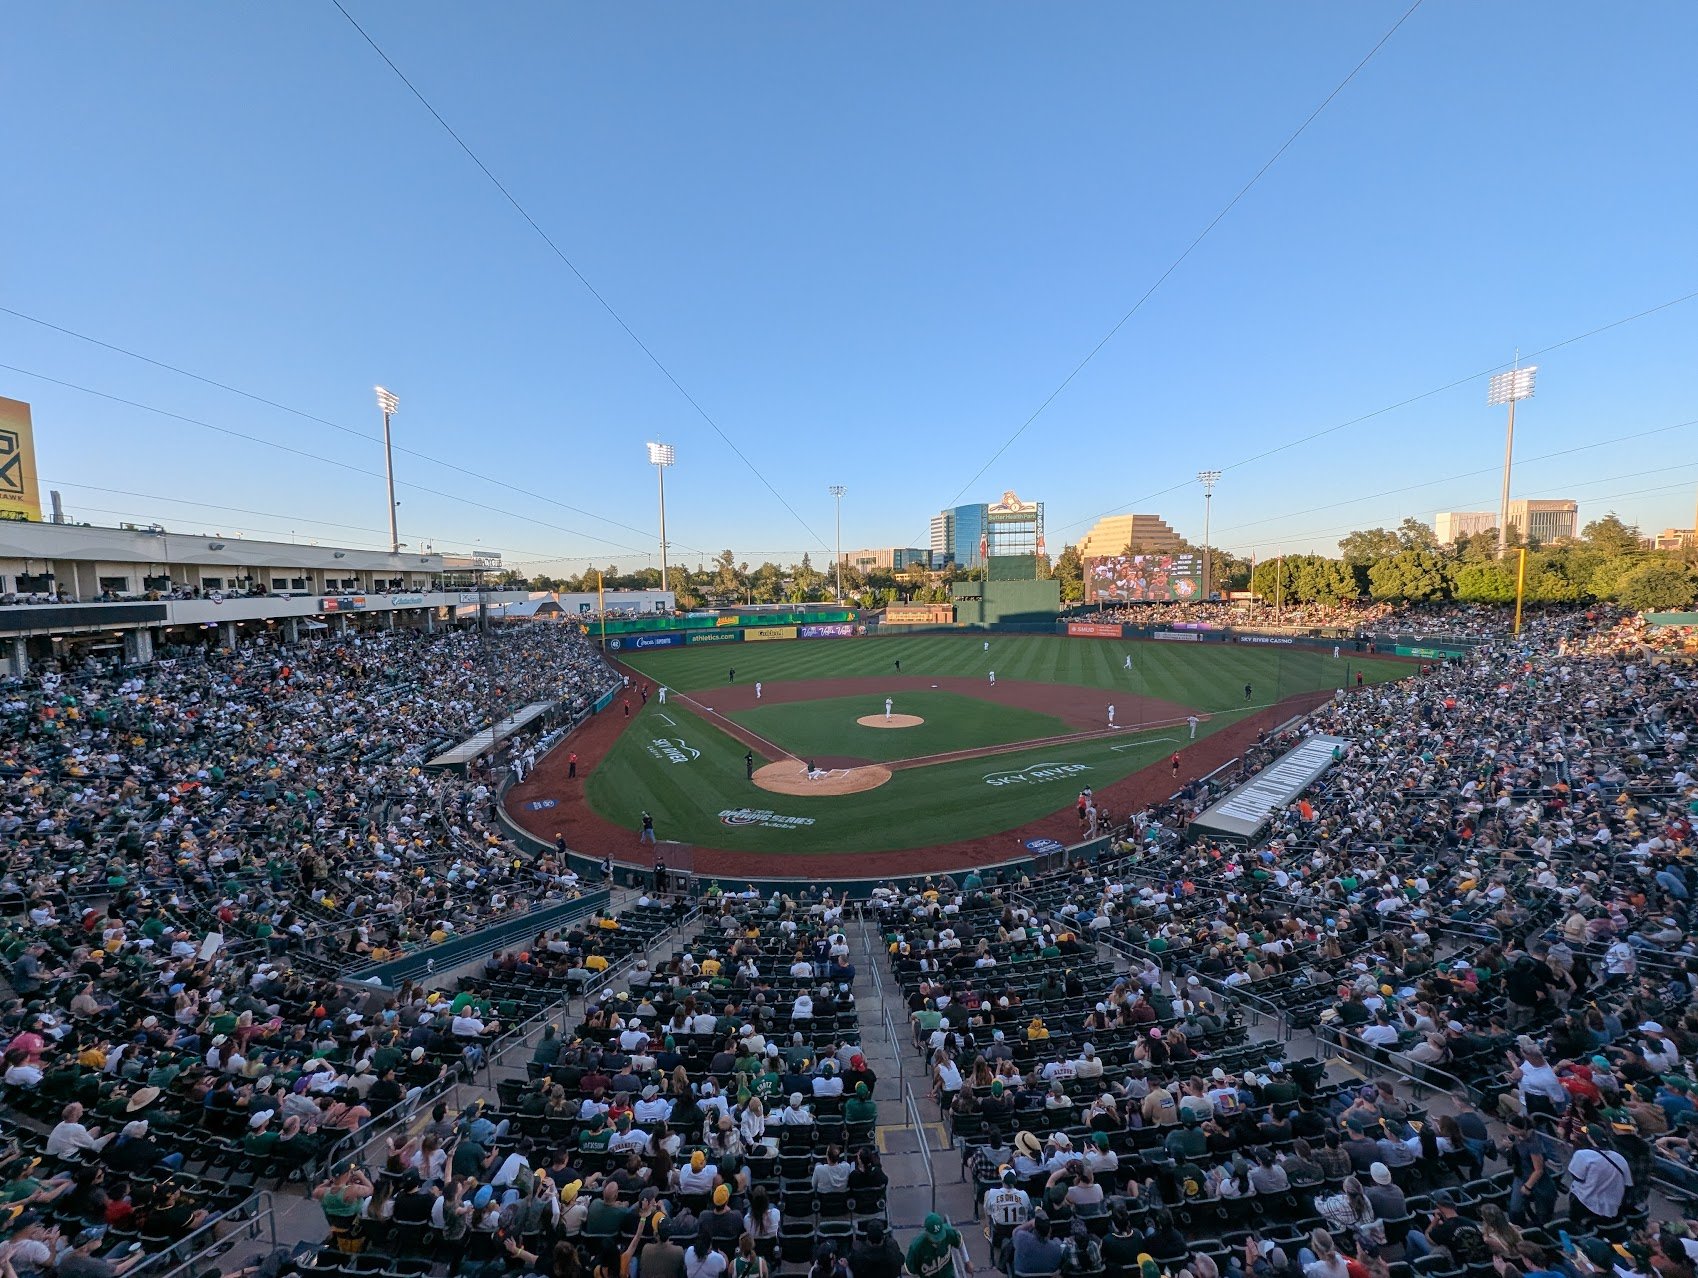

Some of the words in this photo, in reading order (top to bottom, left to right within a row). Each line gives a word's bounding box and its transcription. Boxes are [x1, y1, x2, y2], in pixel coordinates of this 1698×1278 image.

[692, 633, 734, 642] athletics.com
[986, 774, 1027, 786] SKY
[1030, 764, 1090, 778] RIVER
[718, 810, 772, 820] OPENING
[772, 815, 816, 825] SERIES
[1003, 1206, 1017, 1222] 11
